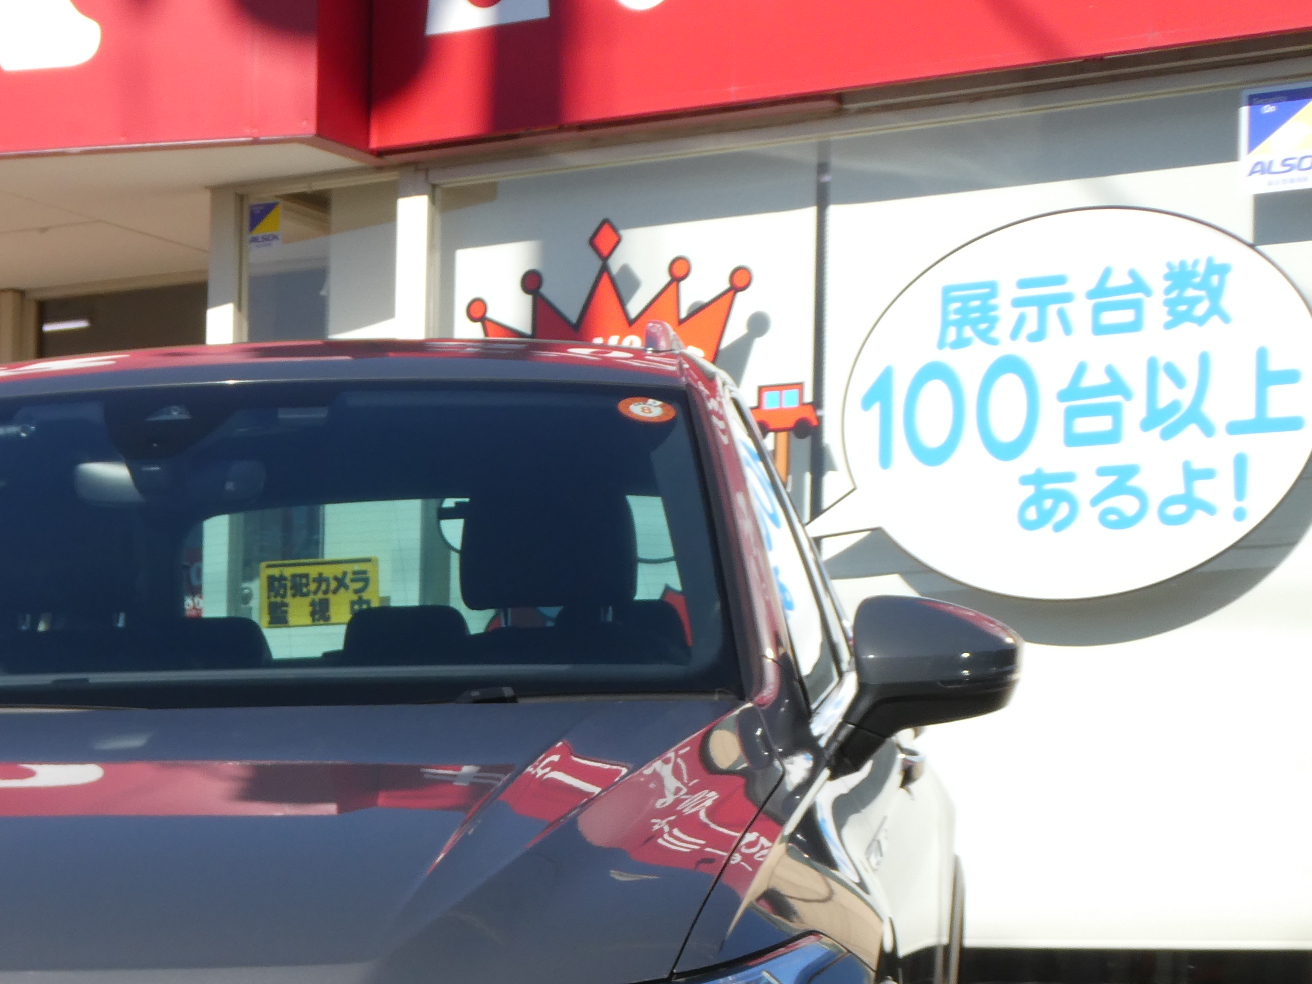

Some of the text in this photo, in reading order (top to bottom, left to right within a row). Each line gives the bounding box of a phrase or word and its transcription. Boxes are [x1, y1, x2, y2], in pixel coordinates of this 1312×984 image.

[936, 256, 1232, 350] 展示台数
[860, 346, 1306, 470] 100台以上
[1017, 452, 1249, 533] あるよ!
[266, 569, 371, 599] 防犯カメラ
